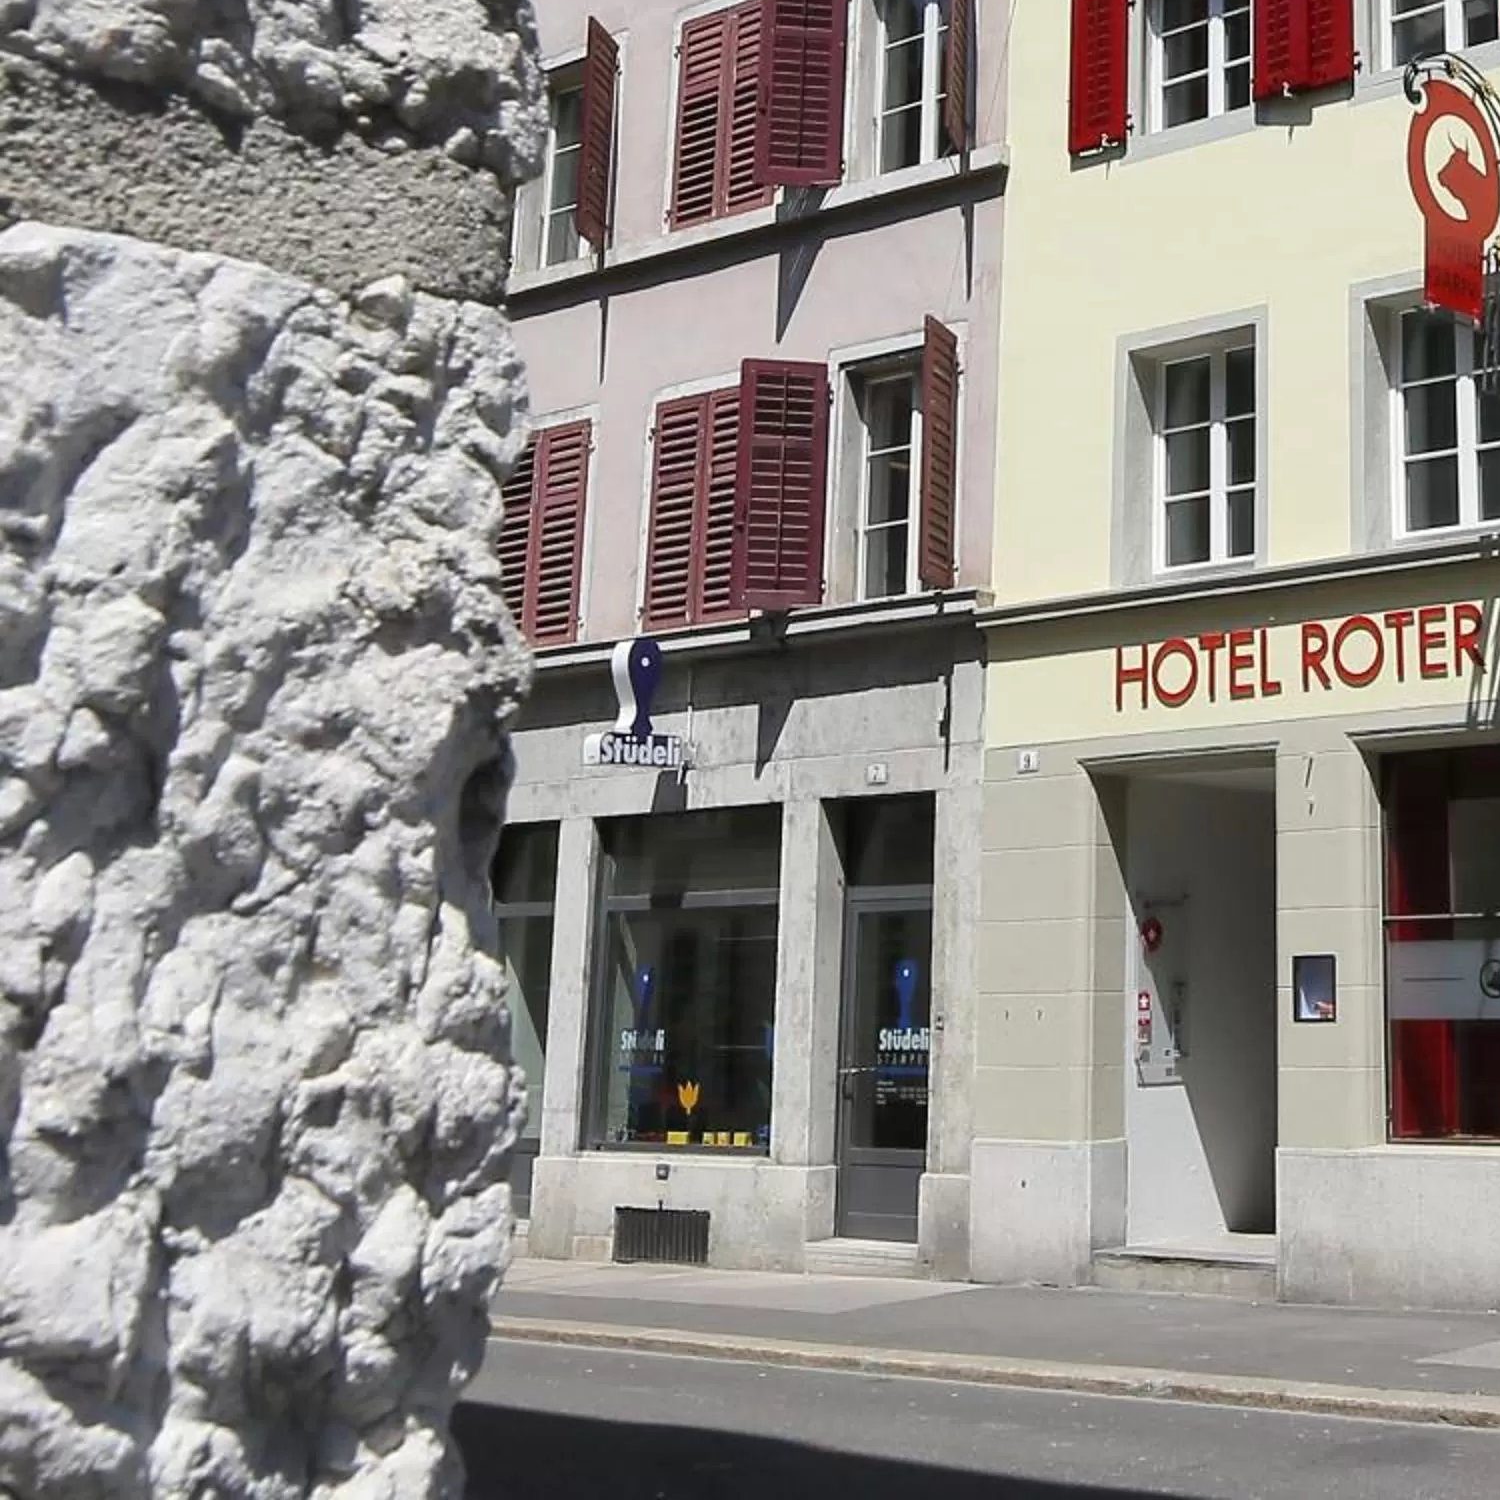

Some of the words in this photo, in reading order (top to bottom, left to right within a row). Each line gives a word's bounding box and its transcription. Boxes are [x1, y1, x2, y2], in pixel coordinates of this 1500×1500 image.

[1115, 627, 1282, 712] HOTEL
[1302, 604, 1487, 694] ROTER
[601, 734, 681, 766] Stüdeli
[879, 1027, 929, 1051] Stüdeli
